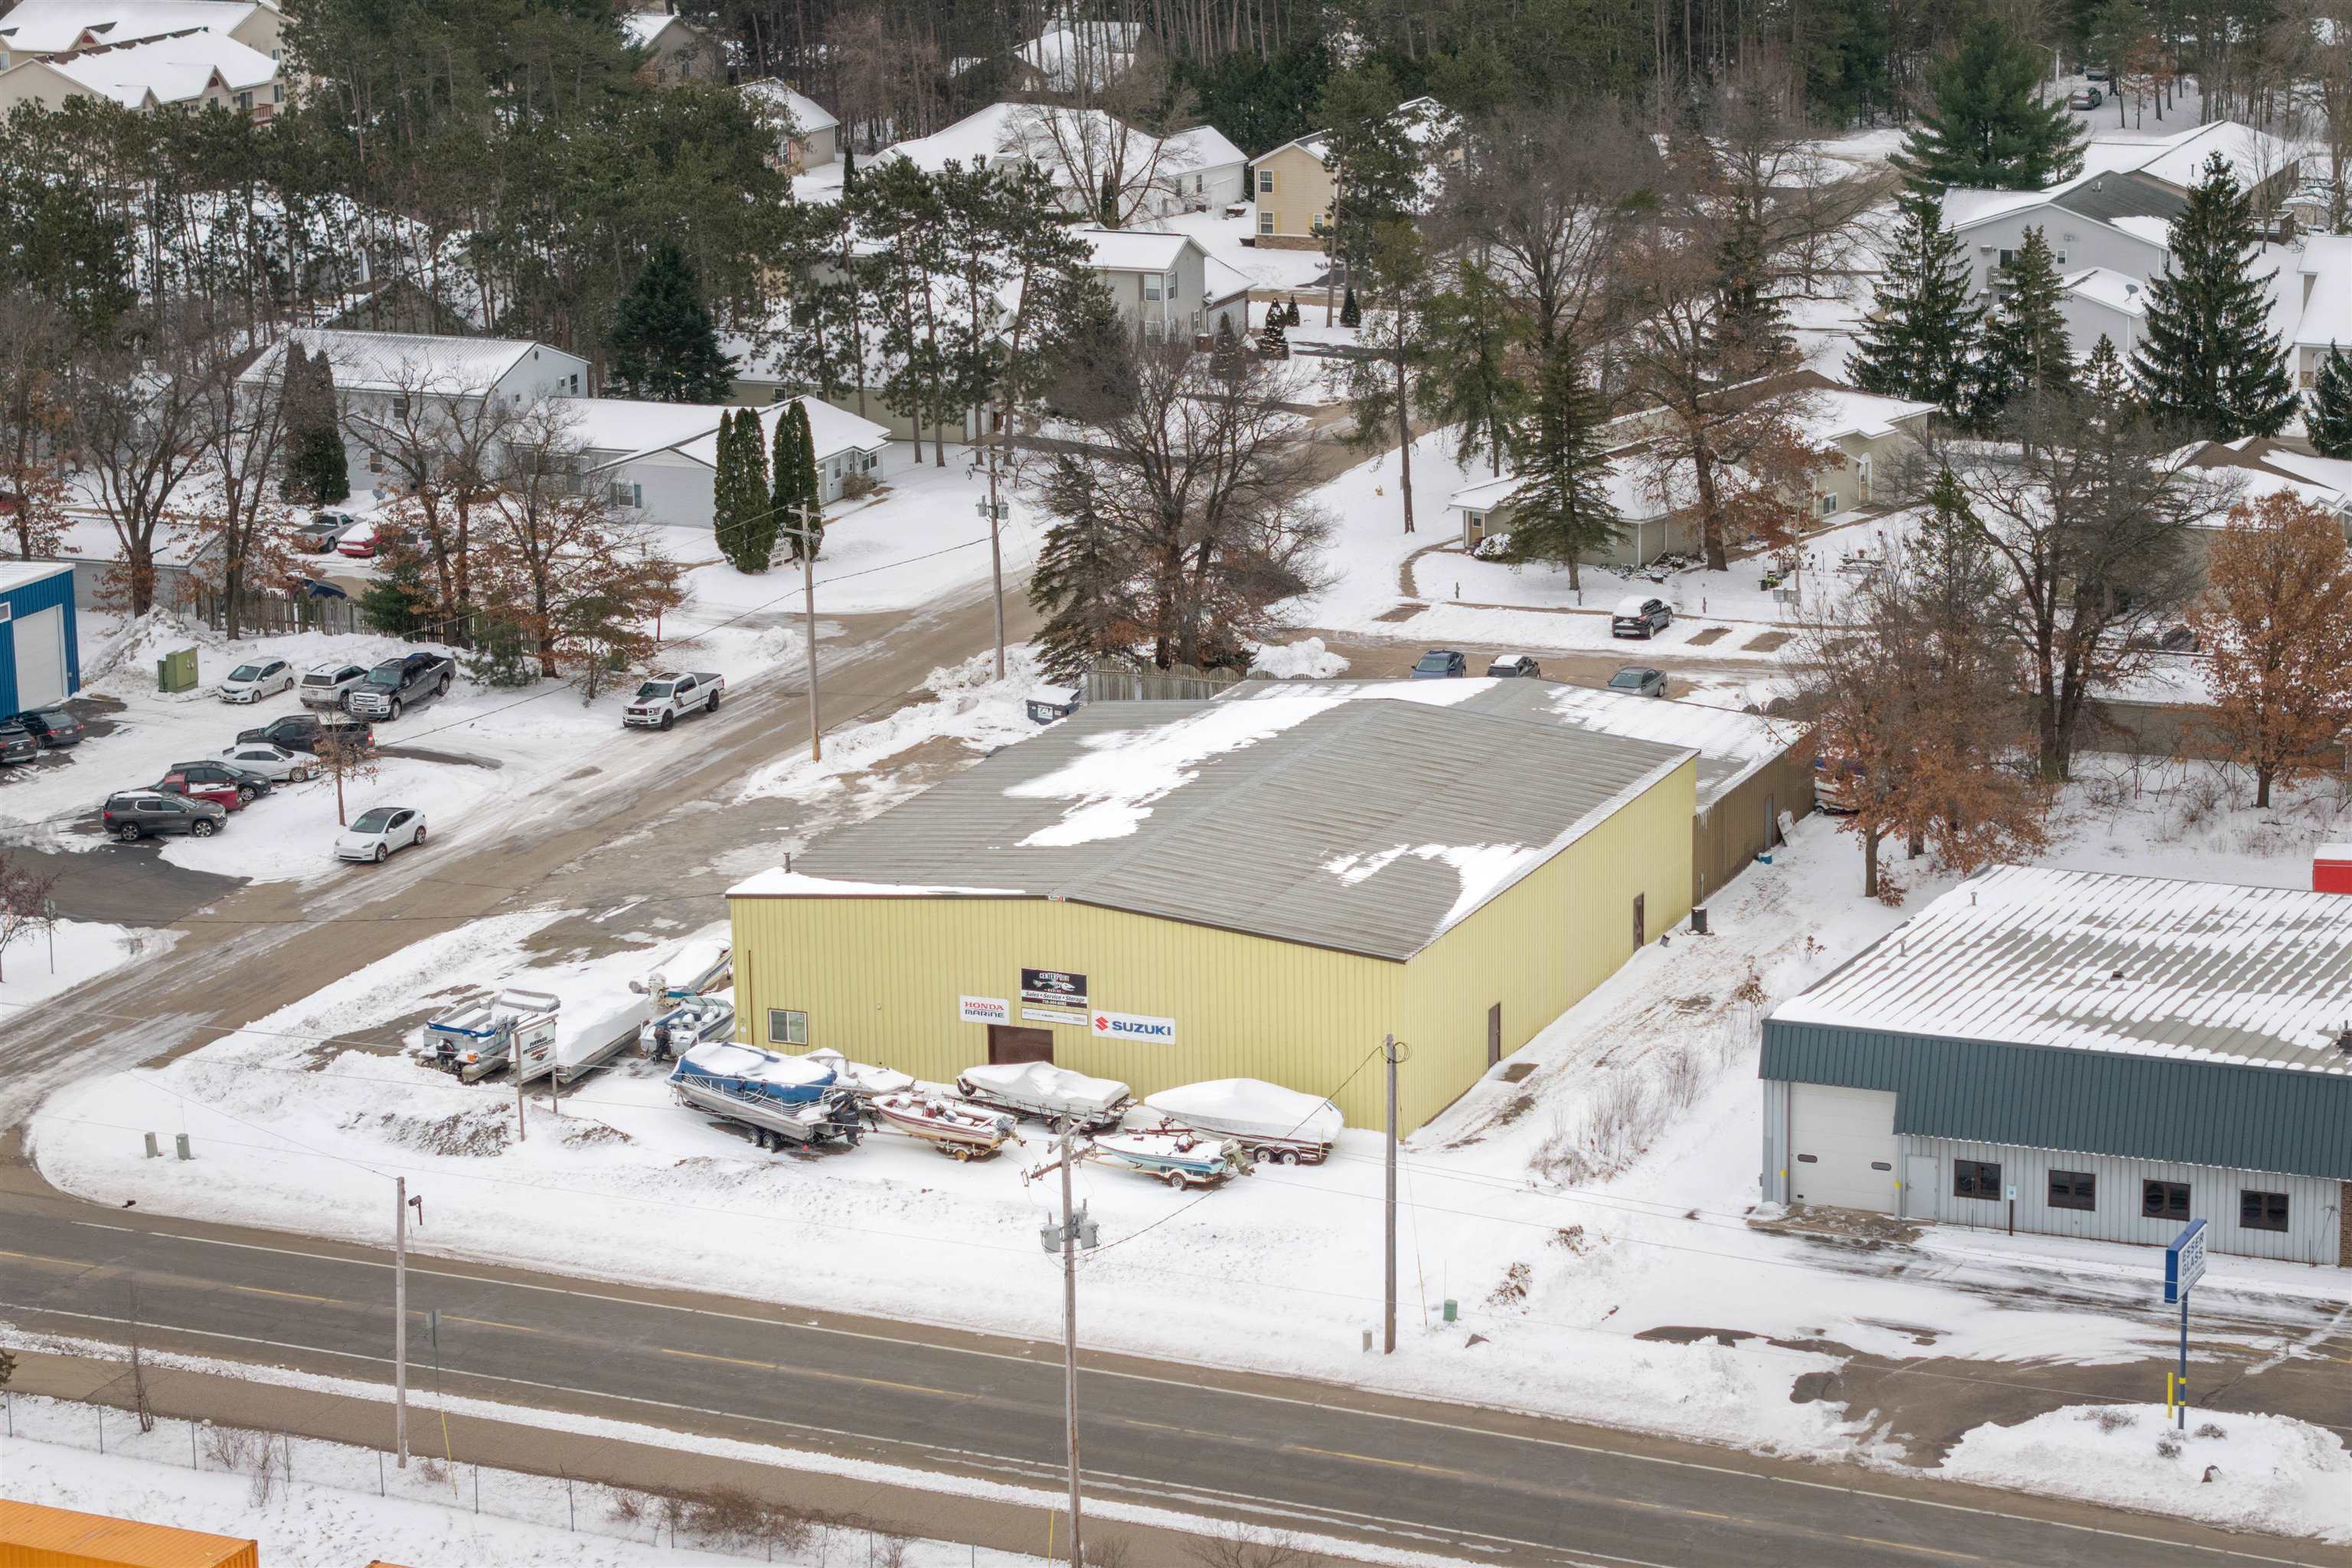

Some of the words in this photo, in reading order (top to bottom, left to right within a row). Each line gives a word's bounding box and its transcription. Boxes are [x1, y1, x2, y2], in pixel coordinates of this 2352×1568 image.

[1039, 972, 1070, 982] CENTERPOINT
[1065, 995, 1085, 1003] Storage
[964, 1001, 1004, 1011] HONDA
[1112, 1021, 1171, 1035] SUZUKI
[2182, 1230, 2203, 1263] ESSER
[2182, 1246, 2203, 1276] GLASS
